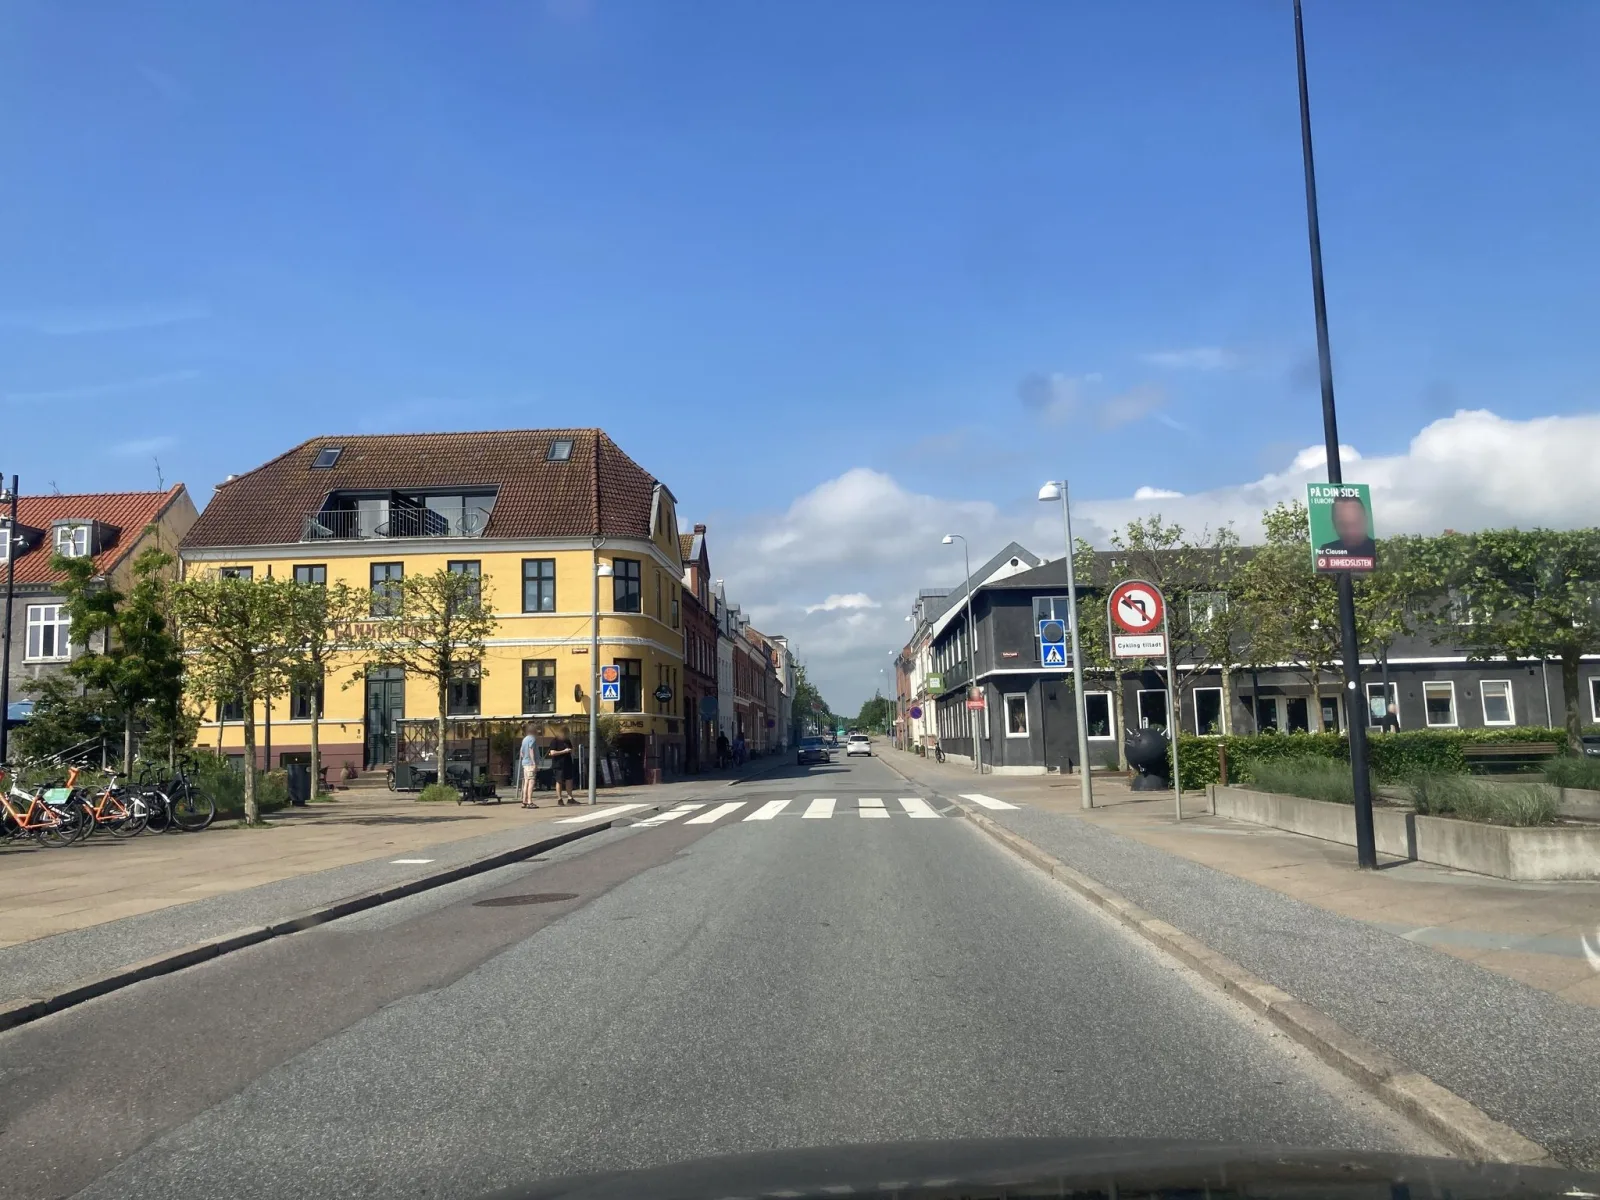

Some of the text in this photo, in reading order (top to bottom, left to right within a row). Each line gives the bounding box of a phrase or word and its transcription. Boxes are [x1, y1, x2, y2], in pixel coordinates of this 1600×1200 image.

[1310, 486, 1360, 498] PÅ DIN SIDE
[1330, 558, 1372, 567] ENHEDSLISTEN
[1117, 642, 1141, 650] Cykling
